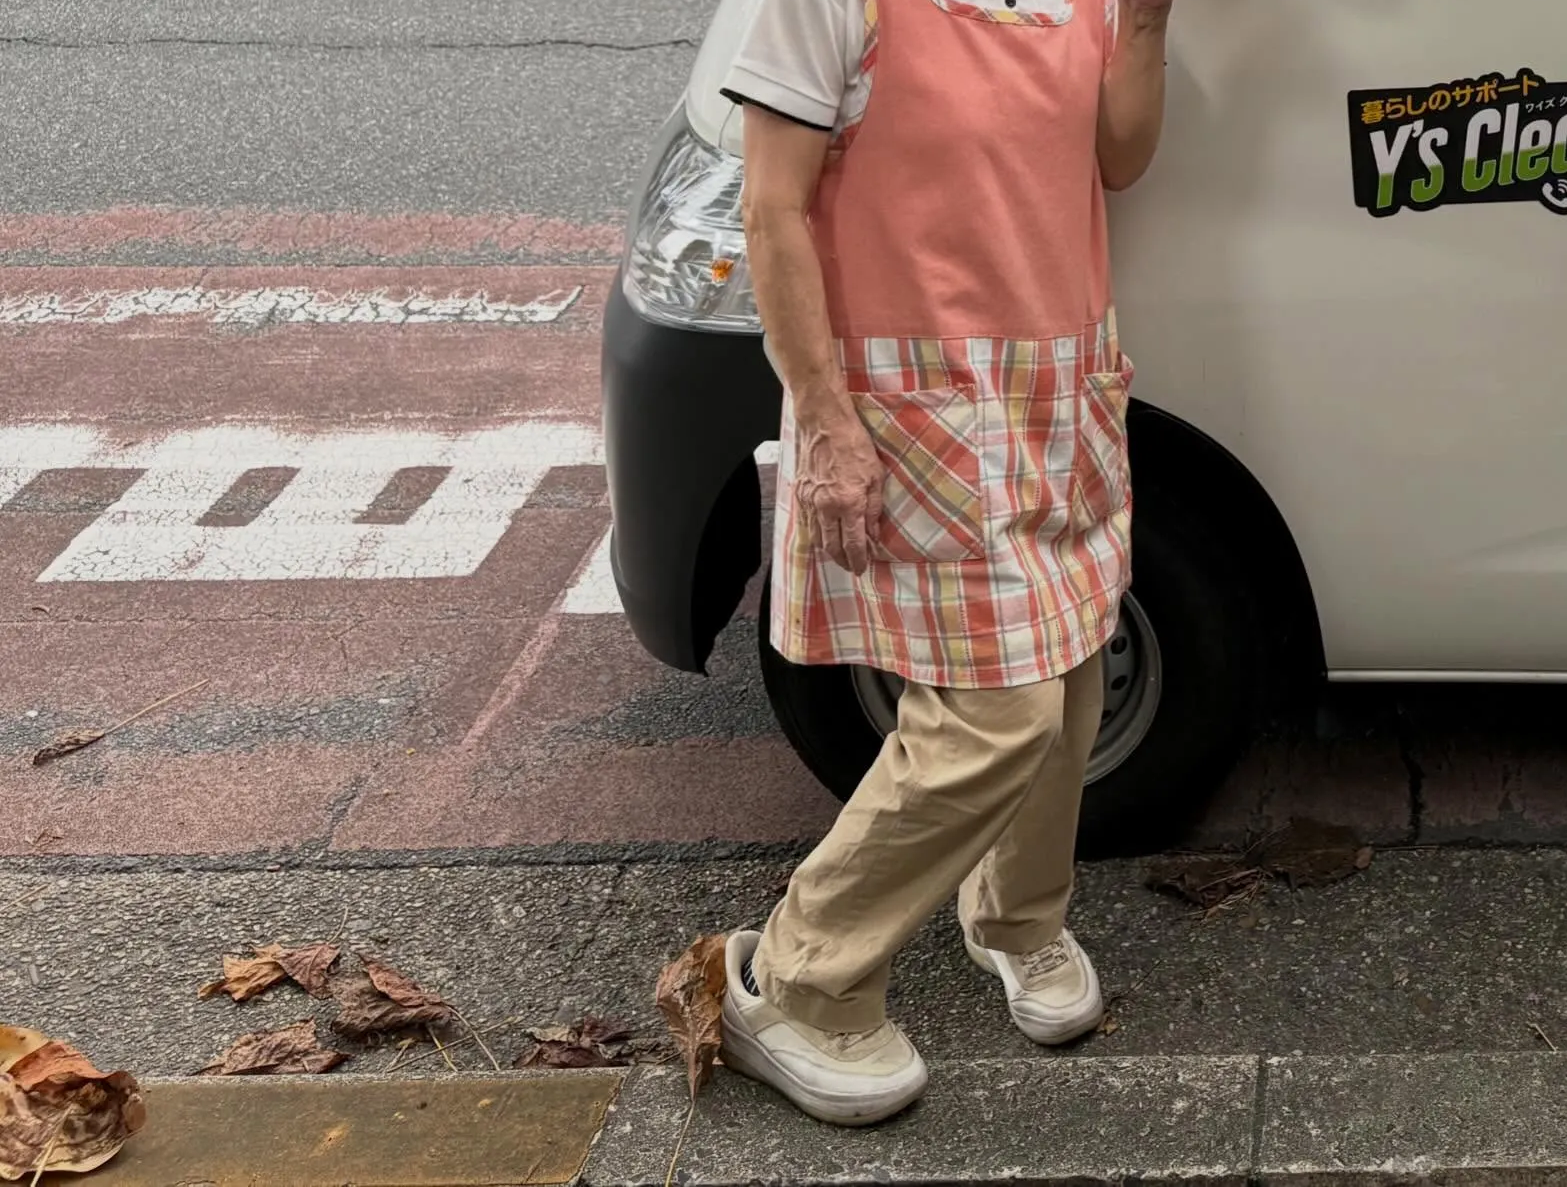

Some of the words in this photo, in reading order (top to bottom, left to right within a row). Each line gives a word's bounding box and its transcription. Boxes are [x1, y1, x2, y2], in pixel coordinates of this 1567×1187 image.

[1360, 75, 1540, 125] 暮らしのサポート
[1525, 97, 1556, 113] ワイズ
[1369, 119, 1449, 209] Y's
